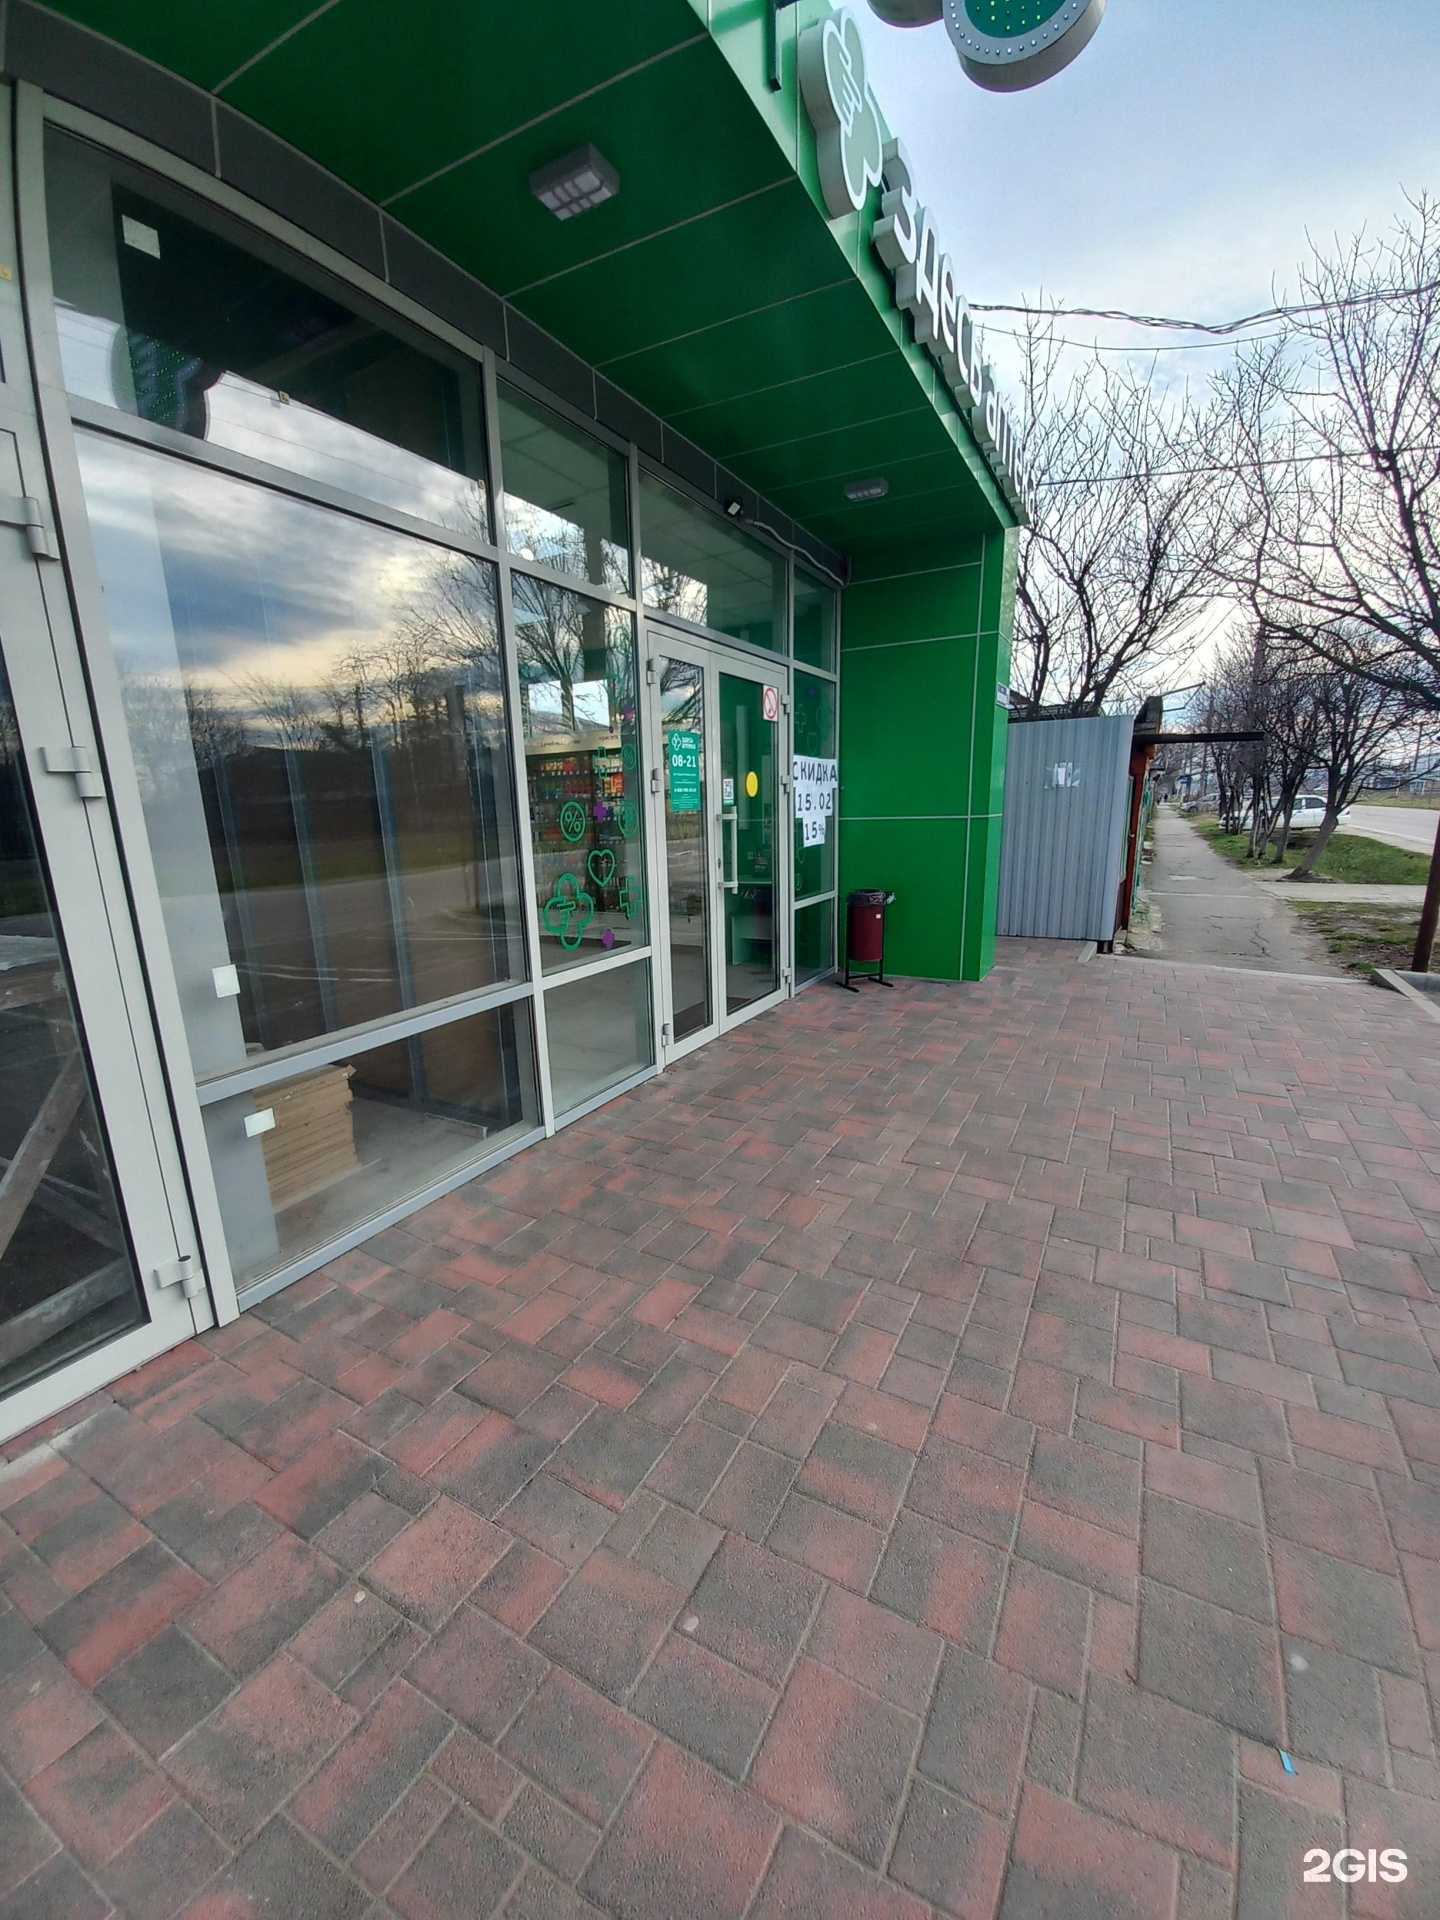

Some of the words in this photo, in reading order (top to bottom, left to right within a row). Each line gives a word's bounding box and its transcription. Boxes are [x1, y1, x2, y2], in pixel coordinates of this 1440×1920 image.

[885, 137, 983, 408] Здесь
[793, 761, 838, 785] СКИДКА
[797, 792, 832, 812] 15.02
[804, 821, 825, 841] 15%
